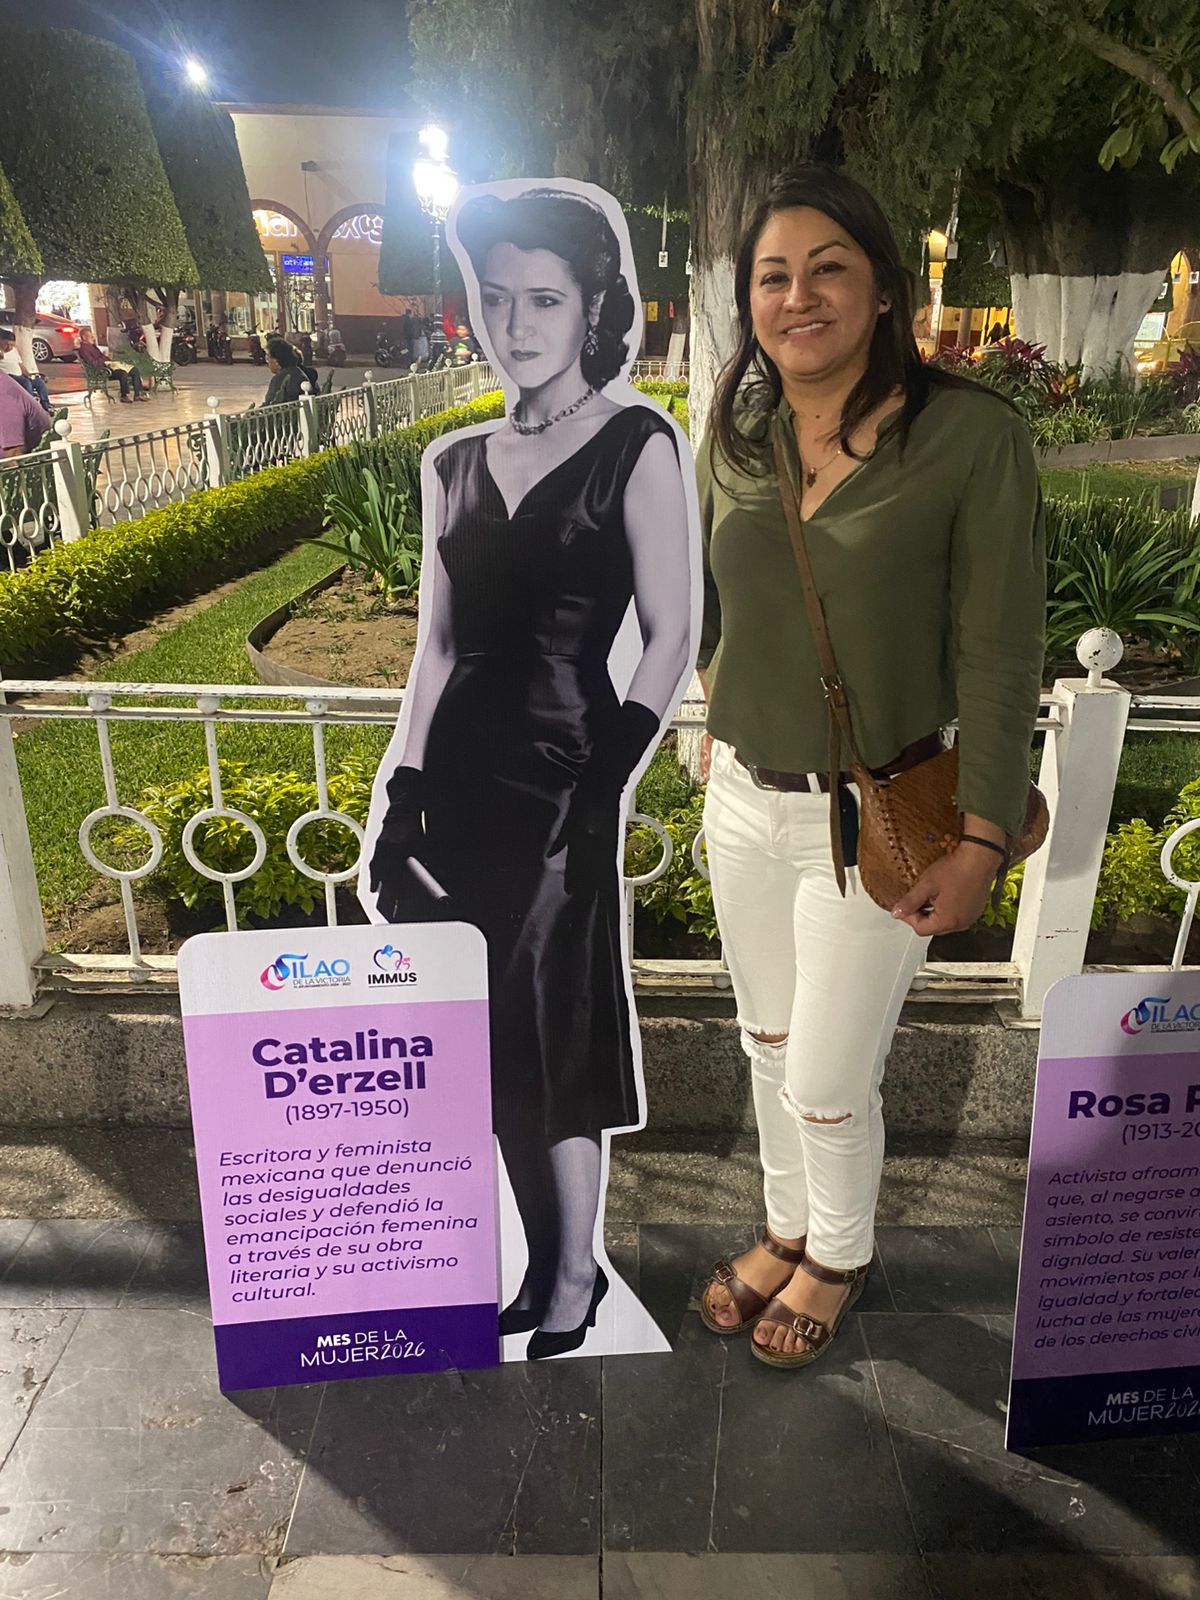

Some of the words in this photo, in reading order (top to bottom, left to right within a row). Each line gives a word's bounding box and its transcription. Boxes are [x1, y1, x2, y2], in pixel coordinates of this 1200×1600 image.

[367, 972, 417, 985] IMMUS
[252, 1029, 433, 1067] Catalina
[286, 1098, 409, 1125] (1897-1950)
[1068, 1090, 1171, 1119] Rosa
[220, 1147, 311, 1166] Escritora
[316, 1147, 330, 1162] y
[335, 1139, 431, 1158] feminista
[221, 1167, 325, 1186] mexicana
[331, 1165, 371, 1181] que
[376, 1156, 472, 1175] denunció
[1048, 1170, 1127, 1185] Activista
[223, 1192, 252, 1206] las
[258, 1181, 411, 1204] desigualdades
[1047, 1194, 1085, 1208] que,
[1090, 1190, 1109, 1203] al
[1112, 1187, 1185, 1204] negarse
[224, 1207, 307, 1226] sociales
[311, 1208, 325, 1222] y
[329, 1198, 420, 1217] defendió
[425, 1197, 443, 1212] la
[1045, 1212, 1114, 1226] asiento,
[1119, 1211, 1140, 1223] se
[226, 1221, 375, 1245] emancipación
[381, 1216, 478, 1233] femenina
[1118, 1230, 1141, 1243] de
[228, 1253, 241, 1265] a
[248, 1246, 311, 1264] través
[316, 1243, 342, 1257] de
[347, 1243, 370, 1255] su
[376, 1238, 423, 1252] obra
[1041, 1250, 1125, 1270] dignidad.
[1130, 1249, 1152, 1262] Su
[230, 1265, 310, 1284] literaria
[315, 1265, 328, 1280] y
[332, 1263, 355, 1275] su
[361, 1255, 458, 1272] activismo
[1040, 1271, 1154, 1288] movimientos
[1158, 1269, 1188, 1283] por
[232, 1283, 316, 1302] cultural.
[1038, 1290, 1119, 1311] igualdad
[1120, 1293, 1134, 1306] y
[1036, 1314, 1085, 1328] lucha
[1090, 1312, 1112, 1325] de
[1117, 1310, 1141, 1322] las
[317, 1333, 351, 1348] MES
[355, 1330, 379, 1345] DE
[384, 1328, 408, 1342] LA
[1034, 1335, 1056, 1348] de
[1061, 1334, 1085, 1347] los
[1089, 1328, 1168, 1344] derechos
[1106, 1391, 1139, 1406] MES
[1143, 1388, 1167, 1402] DE
[1172, 1386, 1193, 1400] LA
